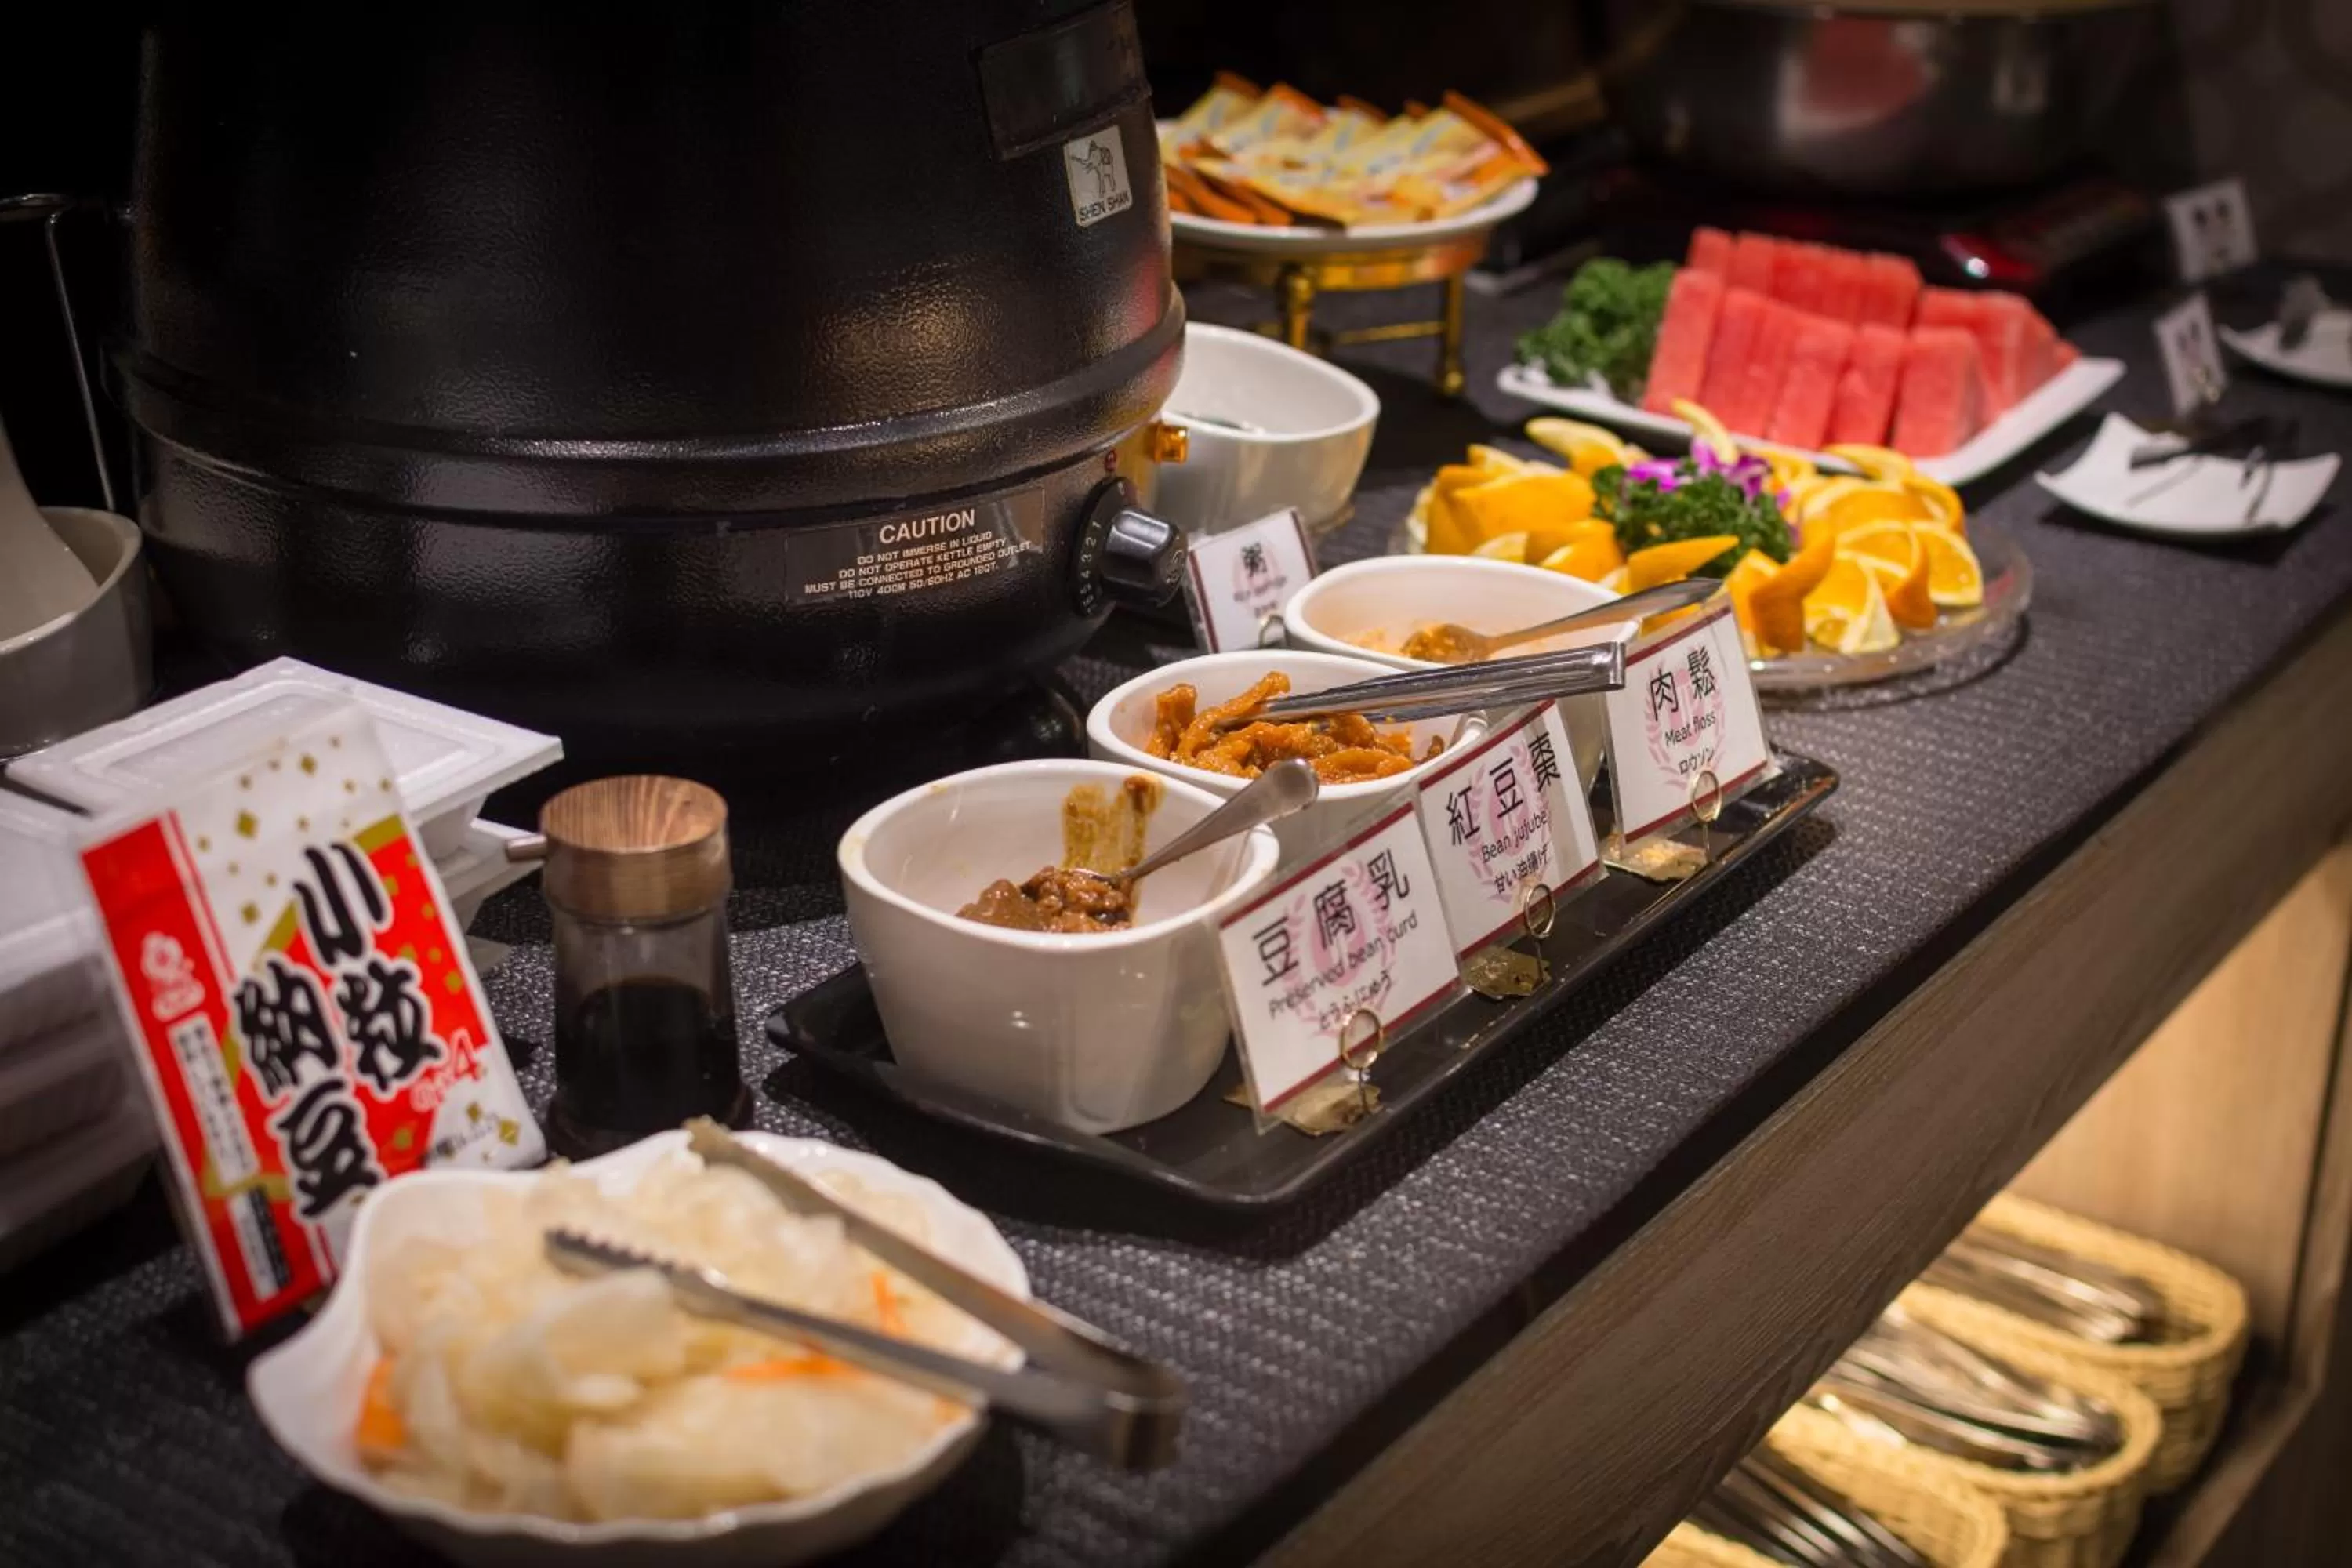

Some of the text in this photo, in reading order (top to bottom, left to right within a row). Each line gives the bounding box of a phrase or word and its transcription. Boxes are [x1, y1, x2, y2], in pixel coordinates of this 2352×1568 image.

[858, 554, 873, 565] DO
[877, 551, 898, 562] NOT
[950, 539, 960, 548] IN
[962, 531, 992, 546] LIQUID
[880, 509, 975, 544] CAUTION
[804, 541, 1032, 593] MUST BE CONNECTED TO GROUNDED OUTLET
[839, 538, 1007, 579] DO NOT OPERATE KETTLE EMPTY
[848, 588, 872, 600] 110V
[957, 568, 971, 579] AC
[1650, 645, 1716, 722] 肉鬆
[1664, 711, 1717, 747] Meat floss
[1446, 731, 1561, 846] 紅豆棗
[1481, 809, 1548, 862] Bean jujube
[1251, 848, 1410, 987] 豆腐乳
[1269, 909, 1418, 1020] Preserved bean curd
[235, 960, 379, 1218] 納豆
